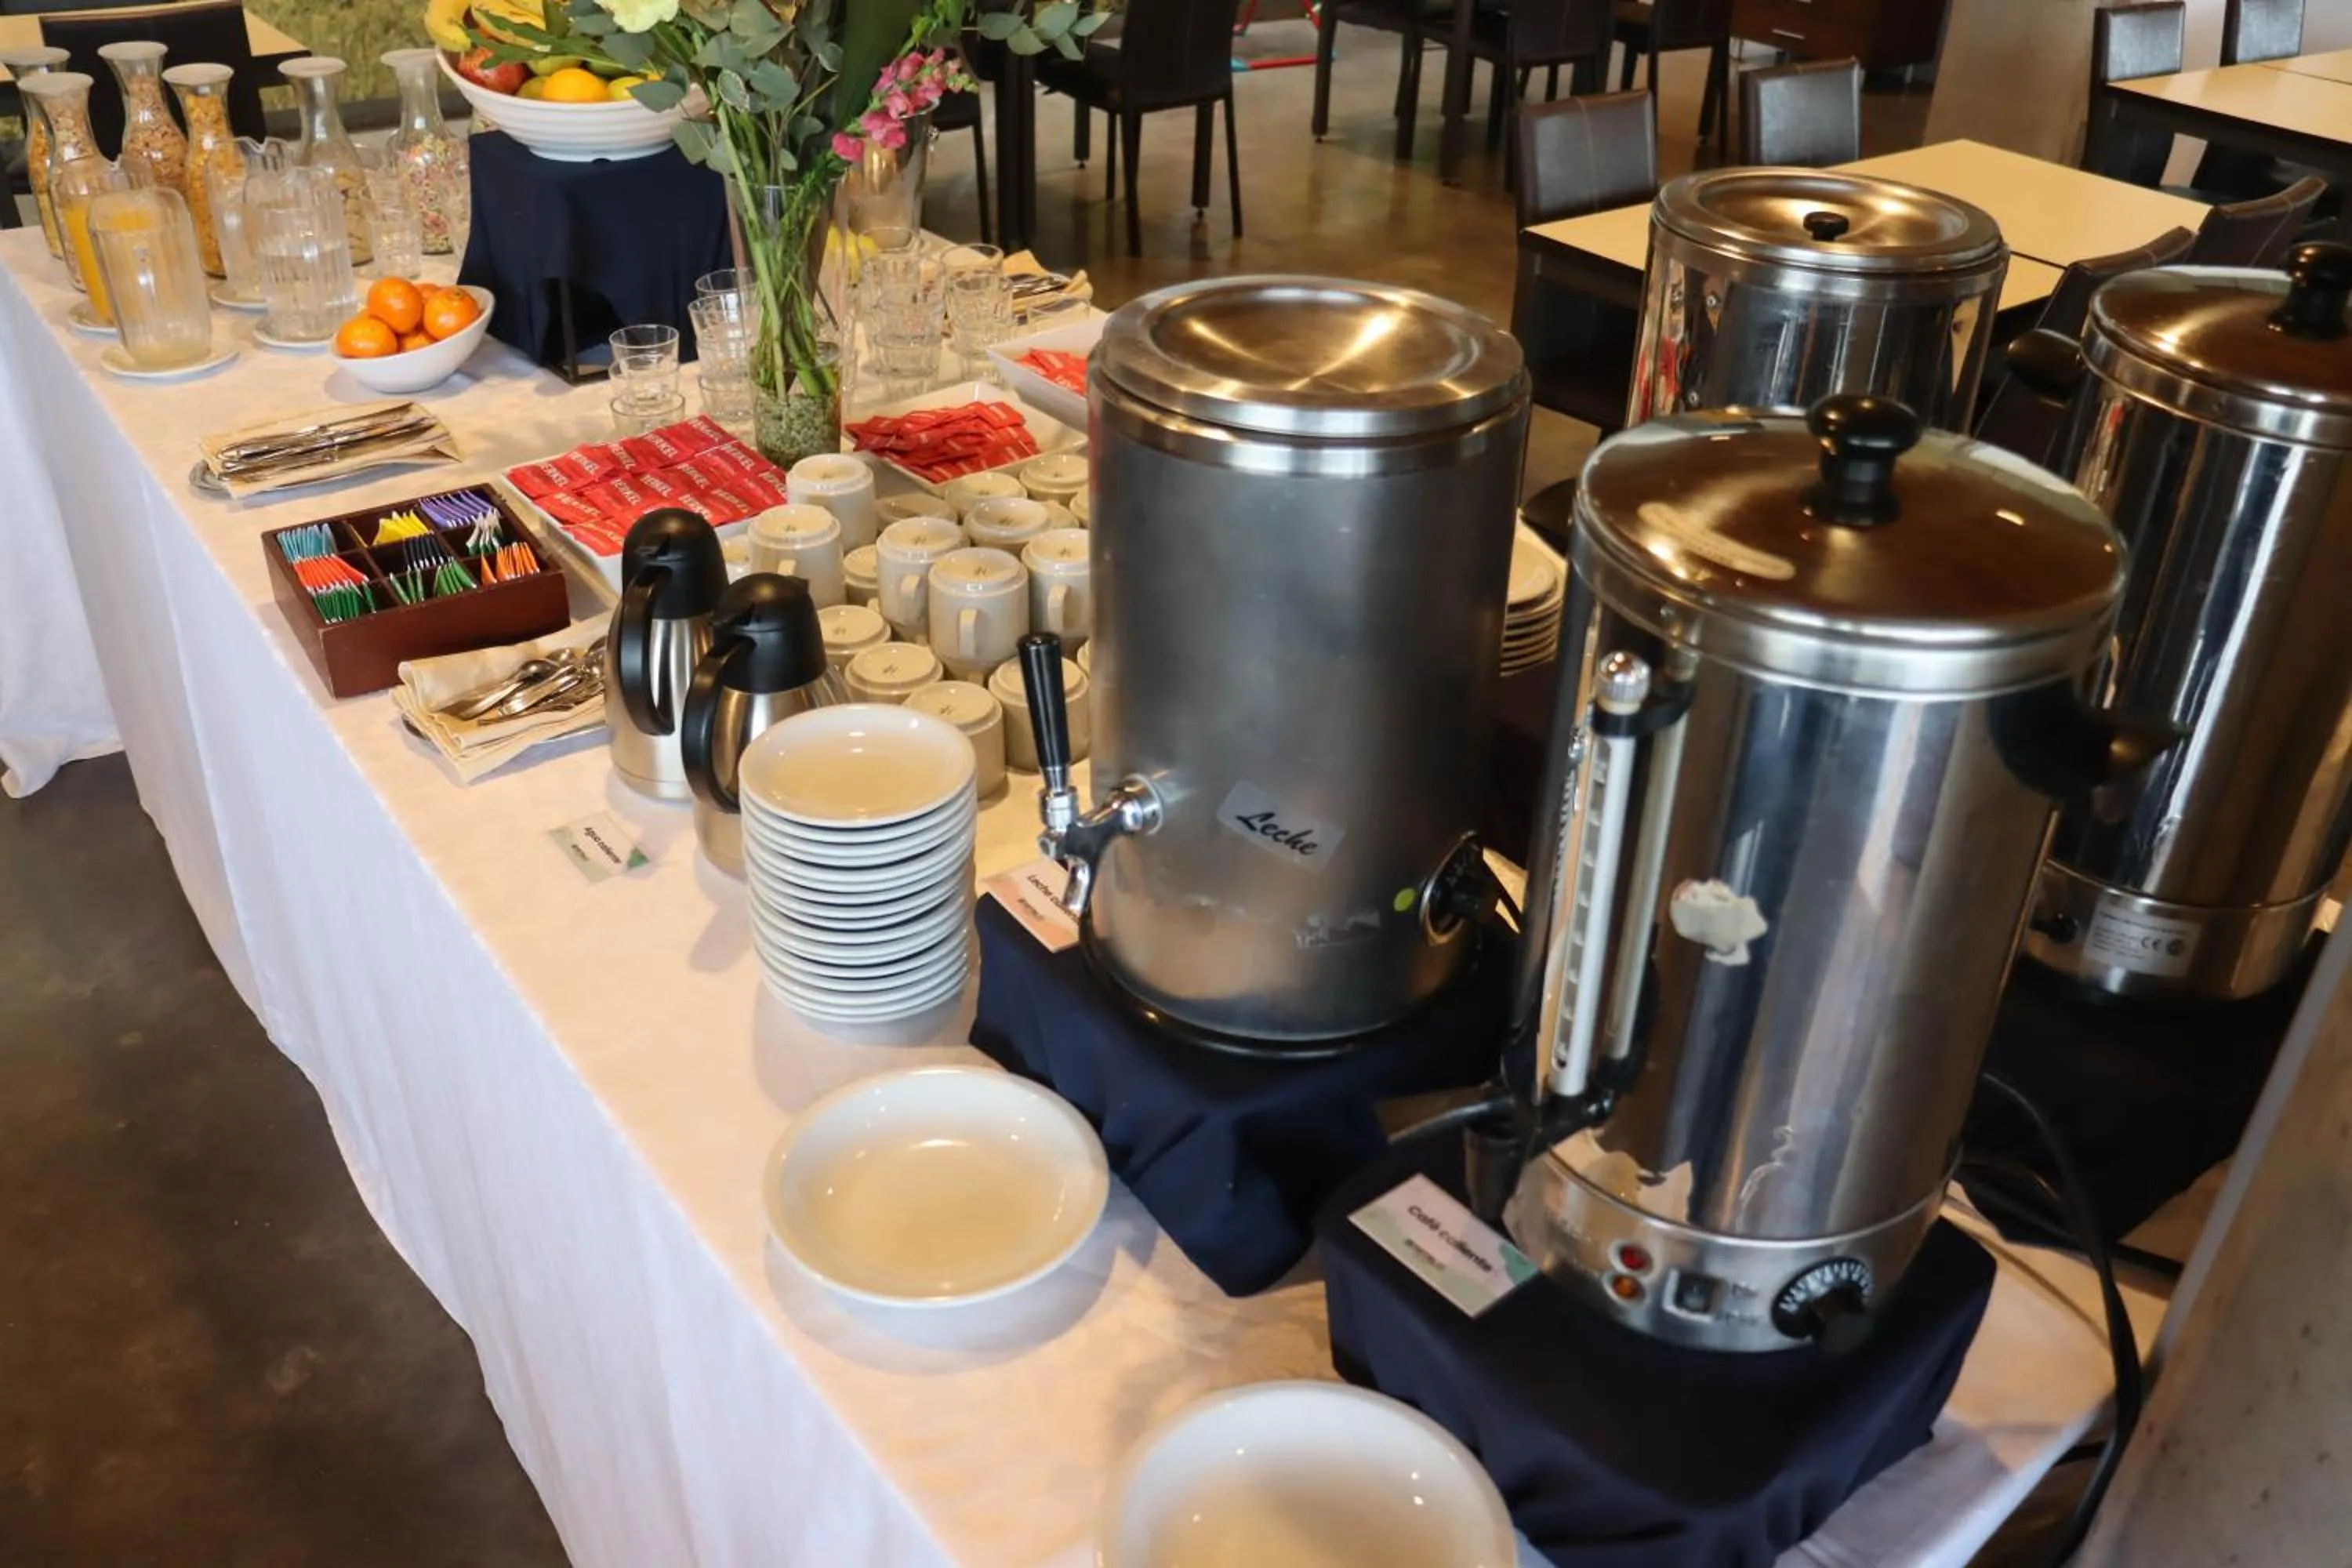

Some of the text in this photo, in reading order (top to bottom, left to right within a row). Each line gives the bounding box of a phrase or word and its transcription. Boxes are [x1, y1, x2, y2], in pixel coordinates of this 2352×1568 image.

[1234, 811, 1319, 856] Leche
[1408, 1205, 1439, 1231] Café
[1438, 1229, 1492, 1272] caliente
